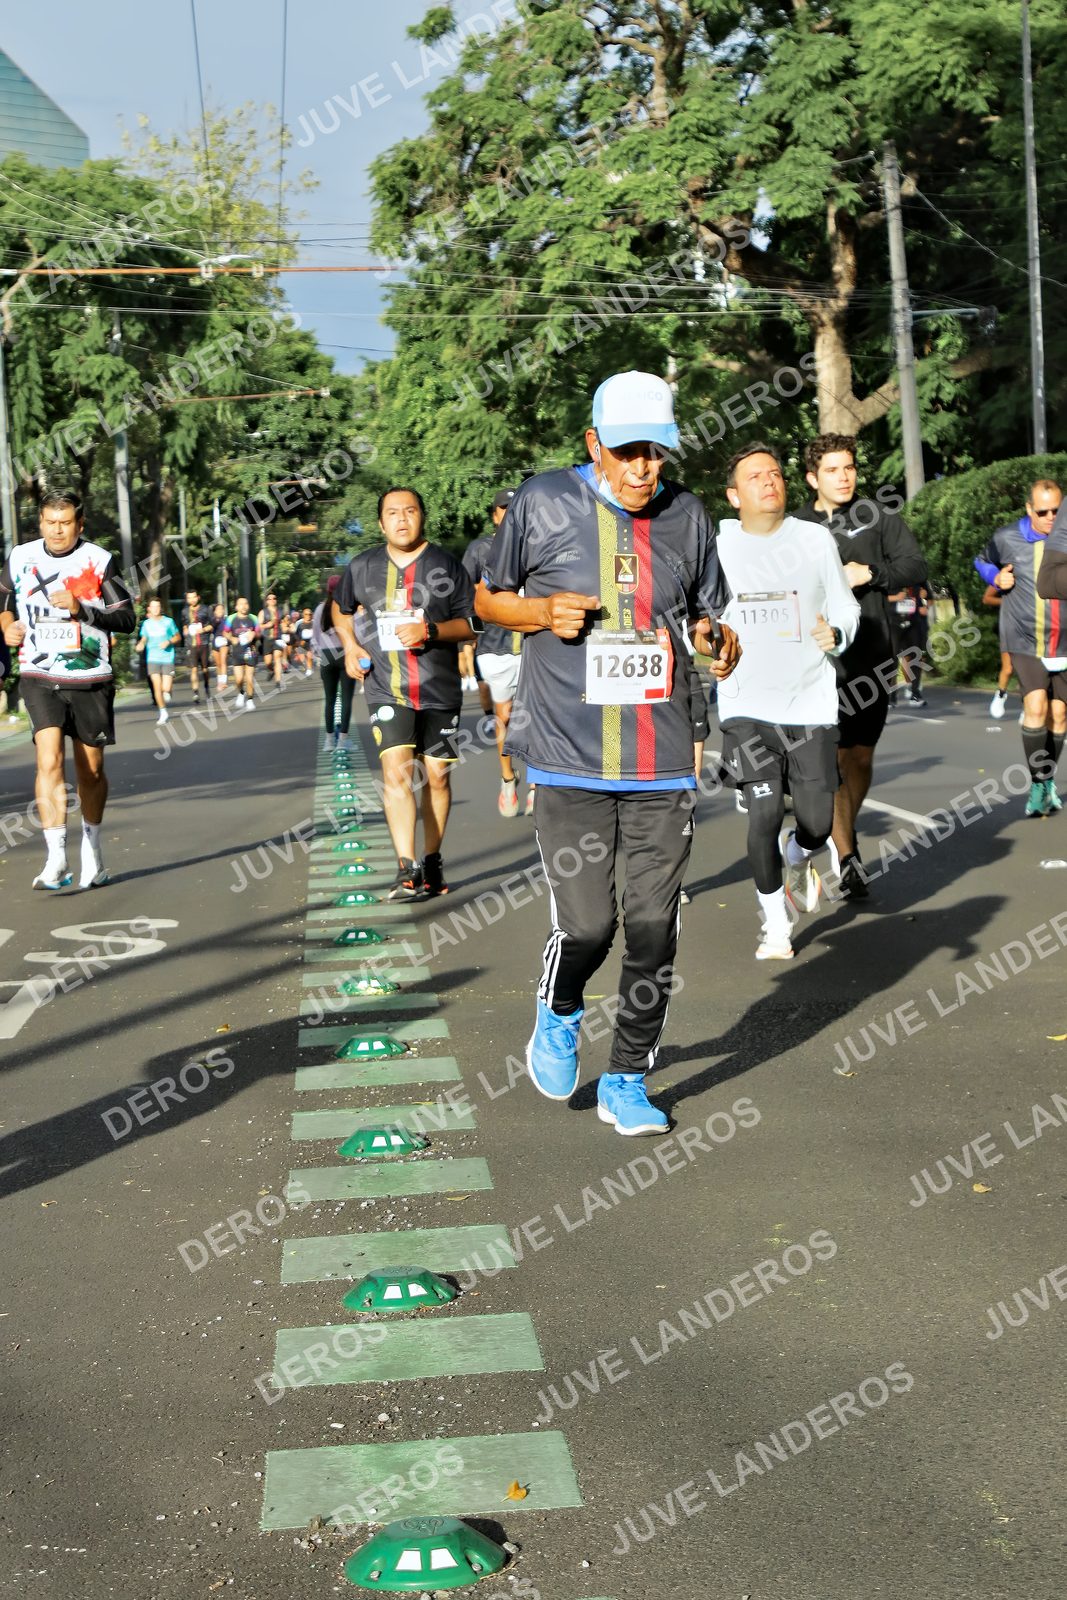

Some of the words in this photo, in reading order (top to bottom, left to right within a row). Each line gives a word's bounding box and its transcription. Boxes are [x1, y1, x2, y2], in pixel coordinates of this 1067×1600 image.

[740, 607, 790, 625] 11305
[38, 627, 74, 640] 12526
[592, 653, 663, 678] 12638
